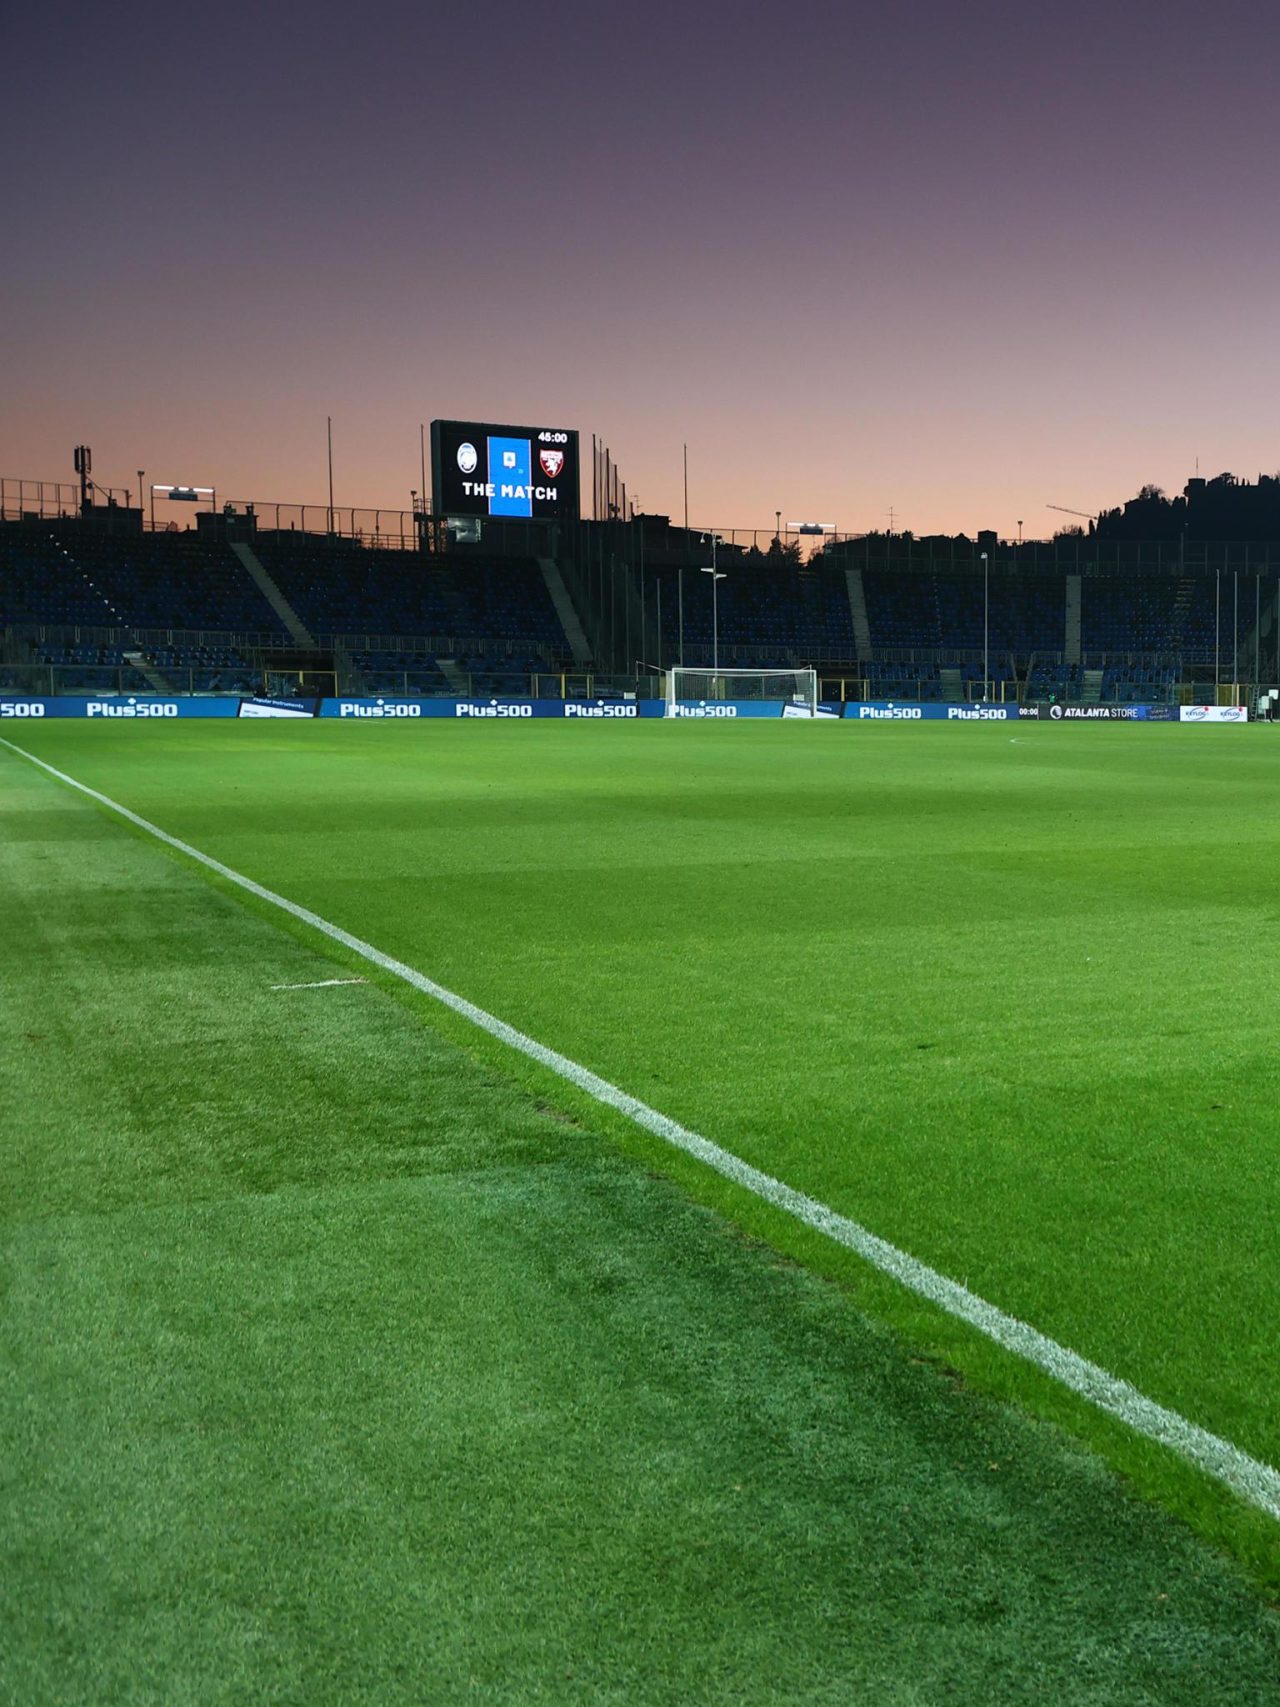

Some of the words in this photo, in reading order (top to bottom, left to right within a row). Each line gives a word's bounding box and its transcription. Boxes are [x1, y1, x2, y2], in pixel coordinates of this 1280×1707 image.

[462, 482, 496, 497] THE
[501, 484, 557, 500] MATCH
[87, 703, 177, 717] Plus500
[340, 703, 421, 717] Plus500
[456, 704, 532, 717] Plus500
[565, 704, 637, 717] Plus500
[668, 704, 737, 717] Plus500
[860, 705, 922, 719] Plus500
[948, 707, 1007, 719] Plus500
[1019, 707, 1038, 716] 00:00
[1064, 707, 1110, 717] ATALANTA
[1111, 707, 1138, 718] STORE
